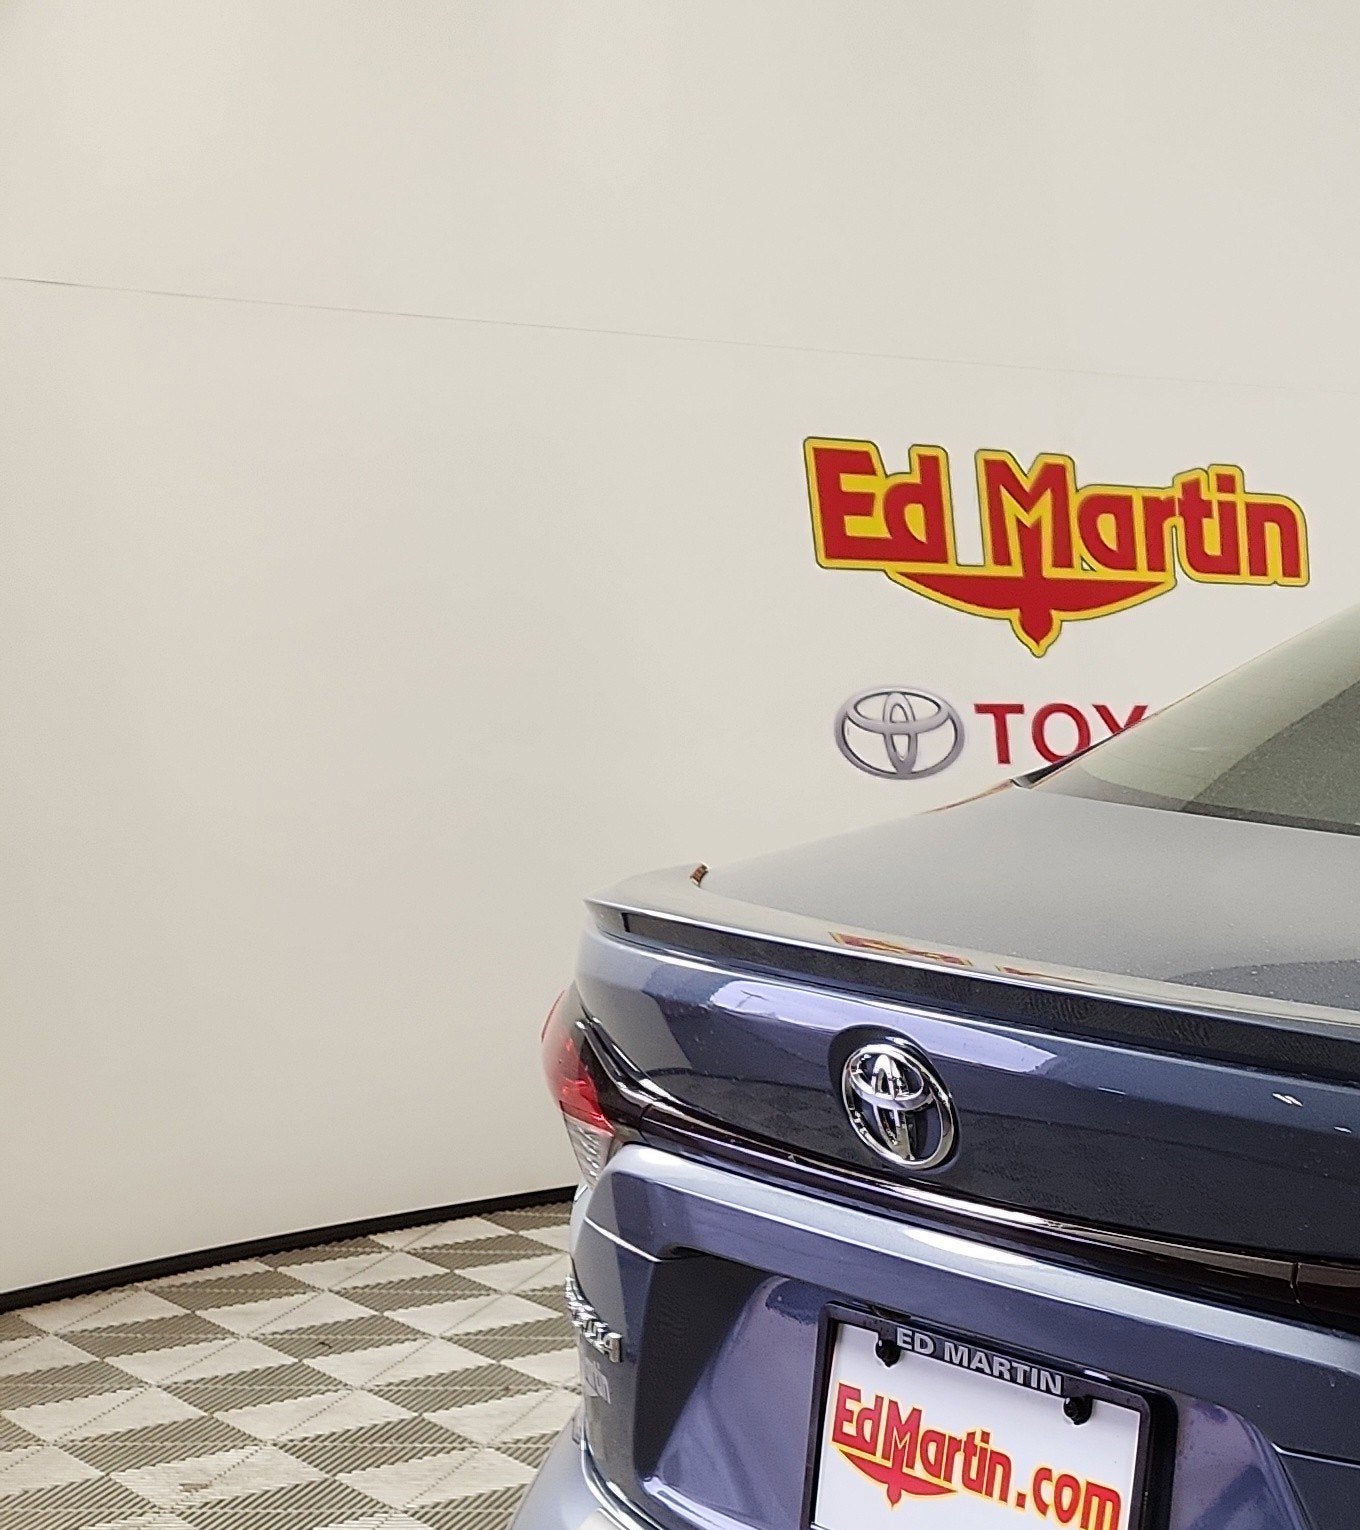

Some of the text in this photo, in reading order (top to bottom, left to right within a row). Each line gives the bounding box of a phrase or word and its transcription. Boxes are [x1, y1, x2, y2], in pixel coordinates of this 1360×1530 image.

[807, 441, 1306, 582] Ed Martin
[895, 1326, 1063, 1395] ED MARTIN
